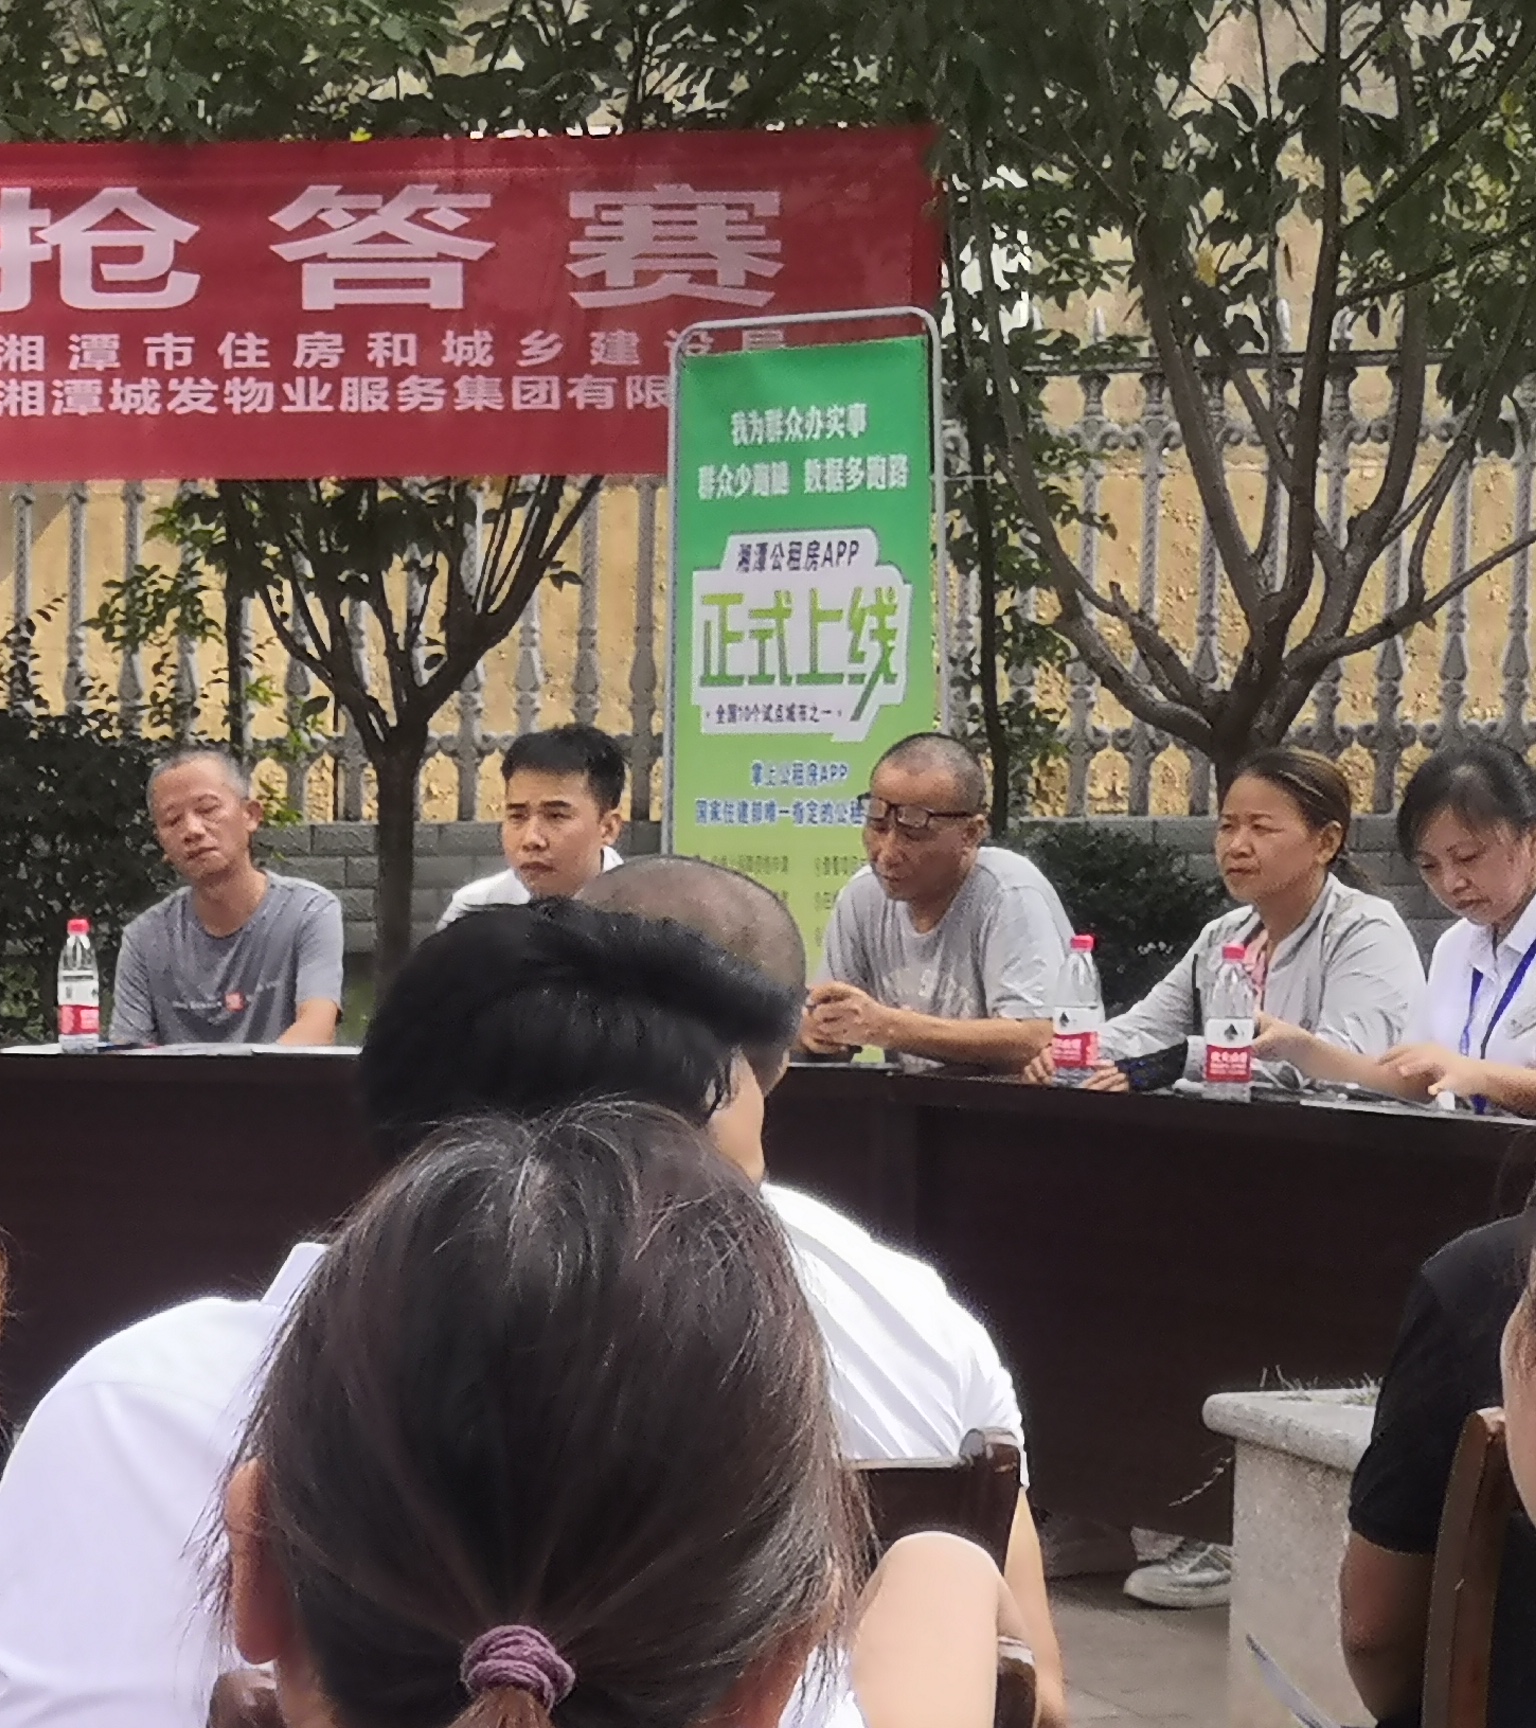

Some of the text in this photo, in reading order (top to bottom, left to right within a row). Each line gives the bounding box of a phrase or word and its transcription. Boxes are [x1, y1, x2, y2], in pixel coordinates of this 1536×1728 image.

[731, 402, 868, 446] 我为群众办实事
[804, 453, 909, 494] 数据多跑路
[735, 539, 861, 574] 湘潭公租房APP
[698, 585, 899, 722] 正式上线
